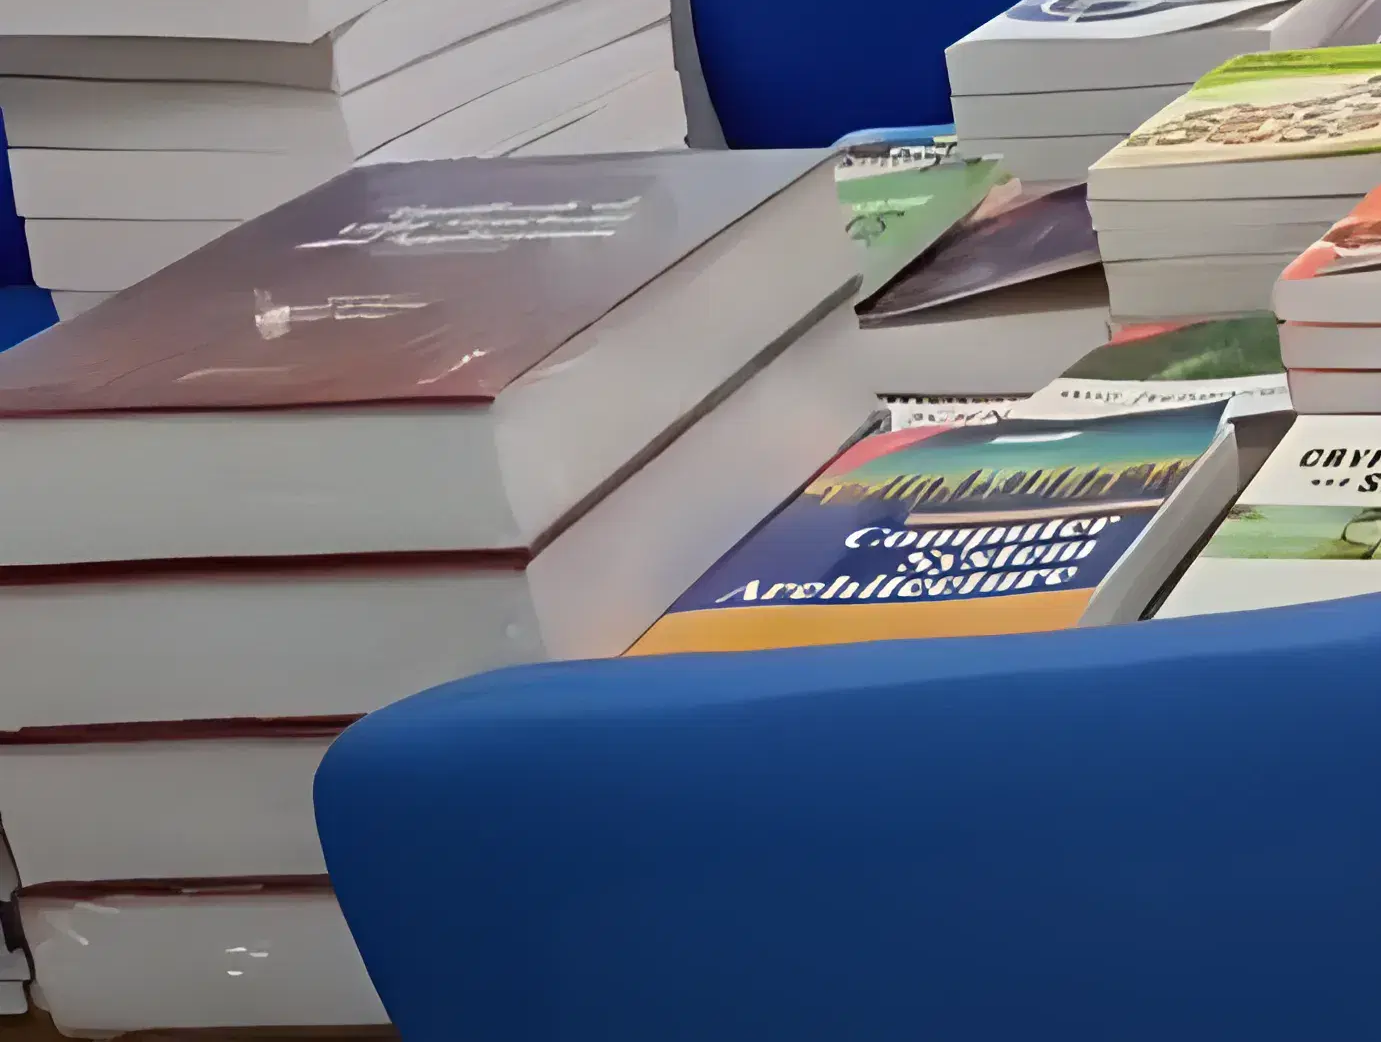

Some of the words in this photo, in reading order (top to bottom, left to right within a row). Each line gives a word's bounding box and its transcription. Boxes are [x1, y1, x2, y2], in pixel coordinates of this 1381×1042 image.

[844, 515, 1122, 556] Computer
[896, 539, 1098, 575] System
[714, 565, 1079, 604] Architecture
